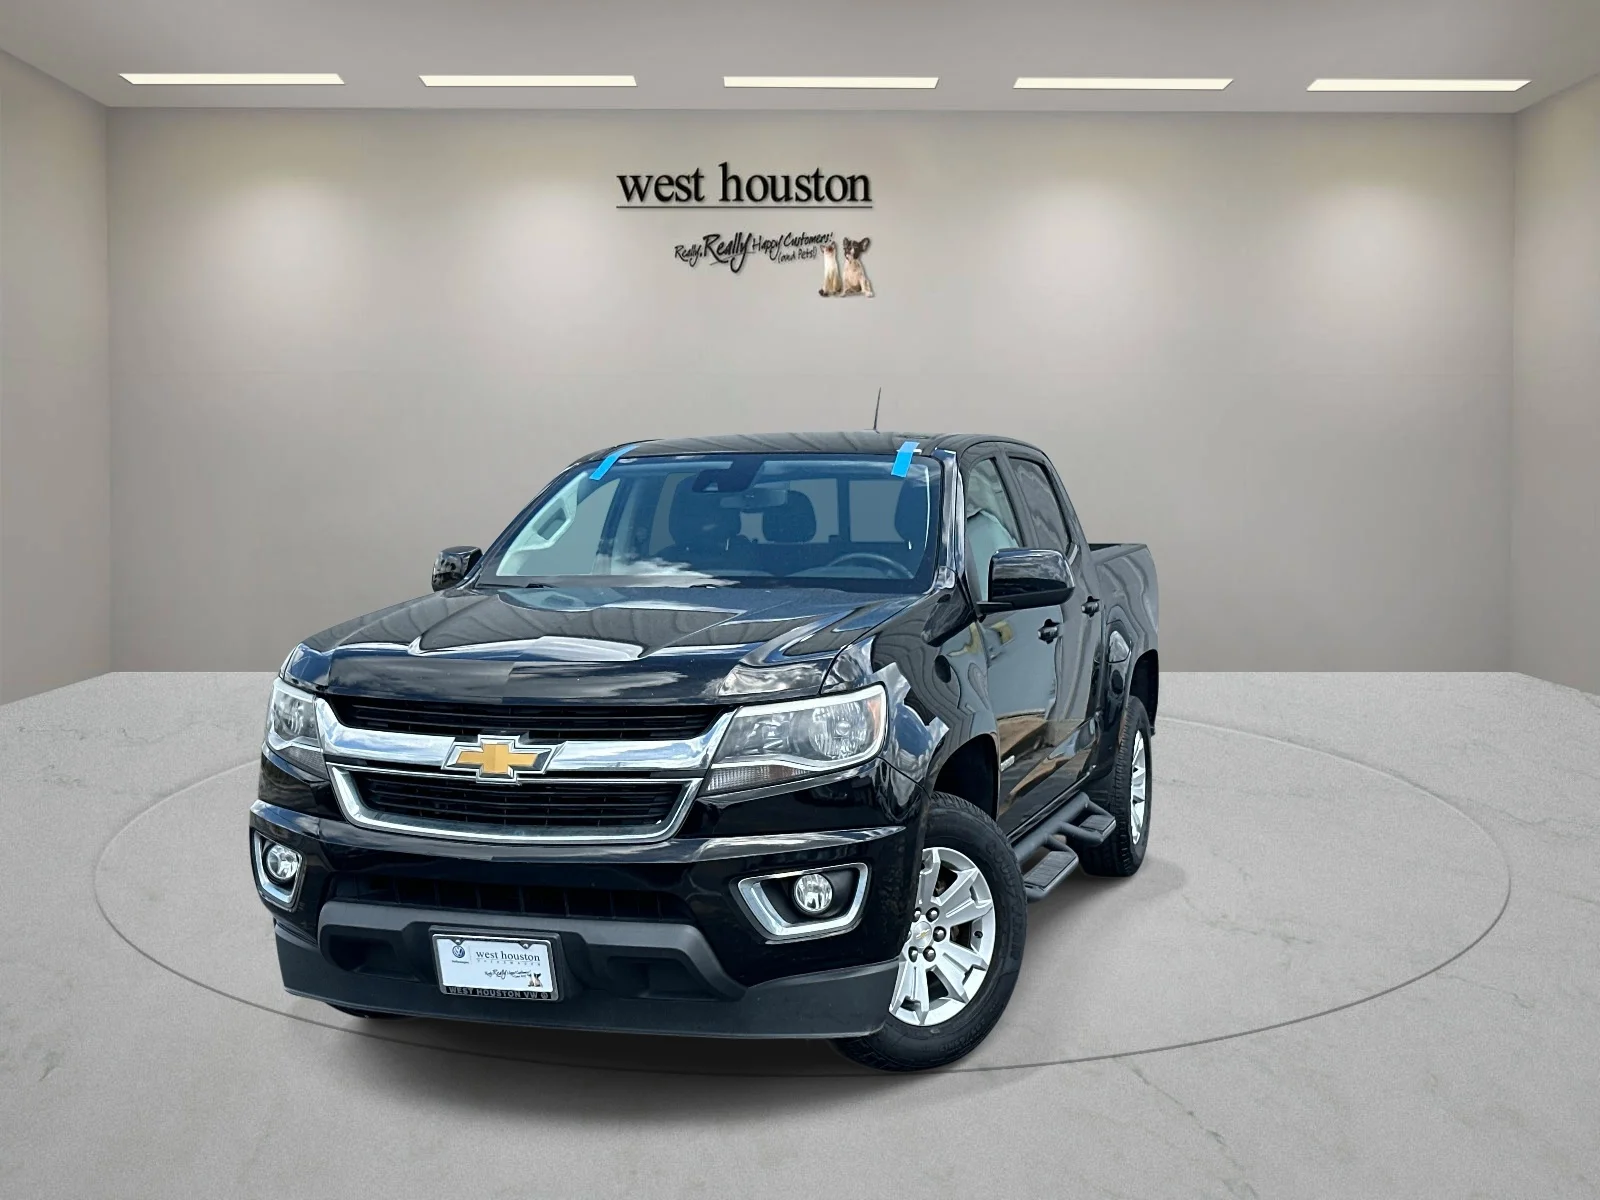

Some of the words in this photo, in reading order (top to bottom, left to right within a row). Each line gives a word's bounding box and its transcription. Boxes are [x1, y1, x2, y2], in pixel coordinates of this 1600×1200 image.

[616, 167, 706, 203] west
[718, 161, 873, 203] houston
[702, 231, 753, 274] Really
[752, 235, 784, 261] Happy
[476, 951, 498, 959] west
[500, 950, 540, 961] houston
[477, 989, 521, 998] HOUSTON
